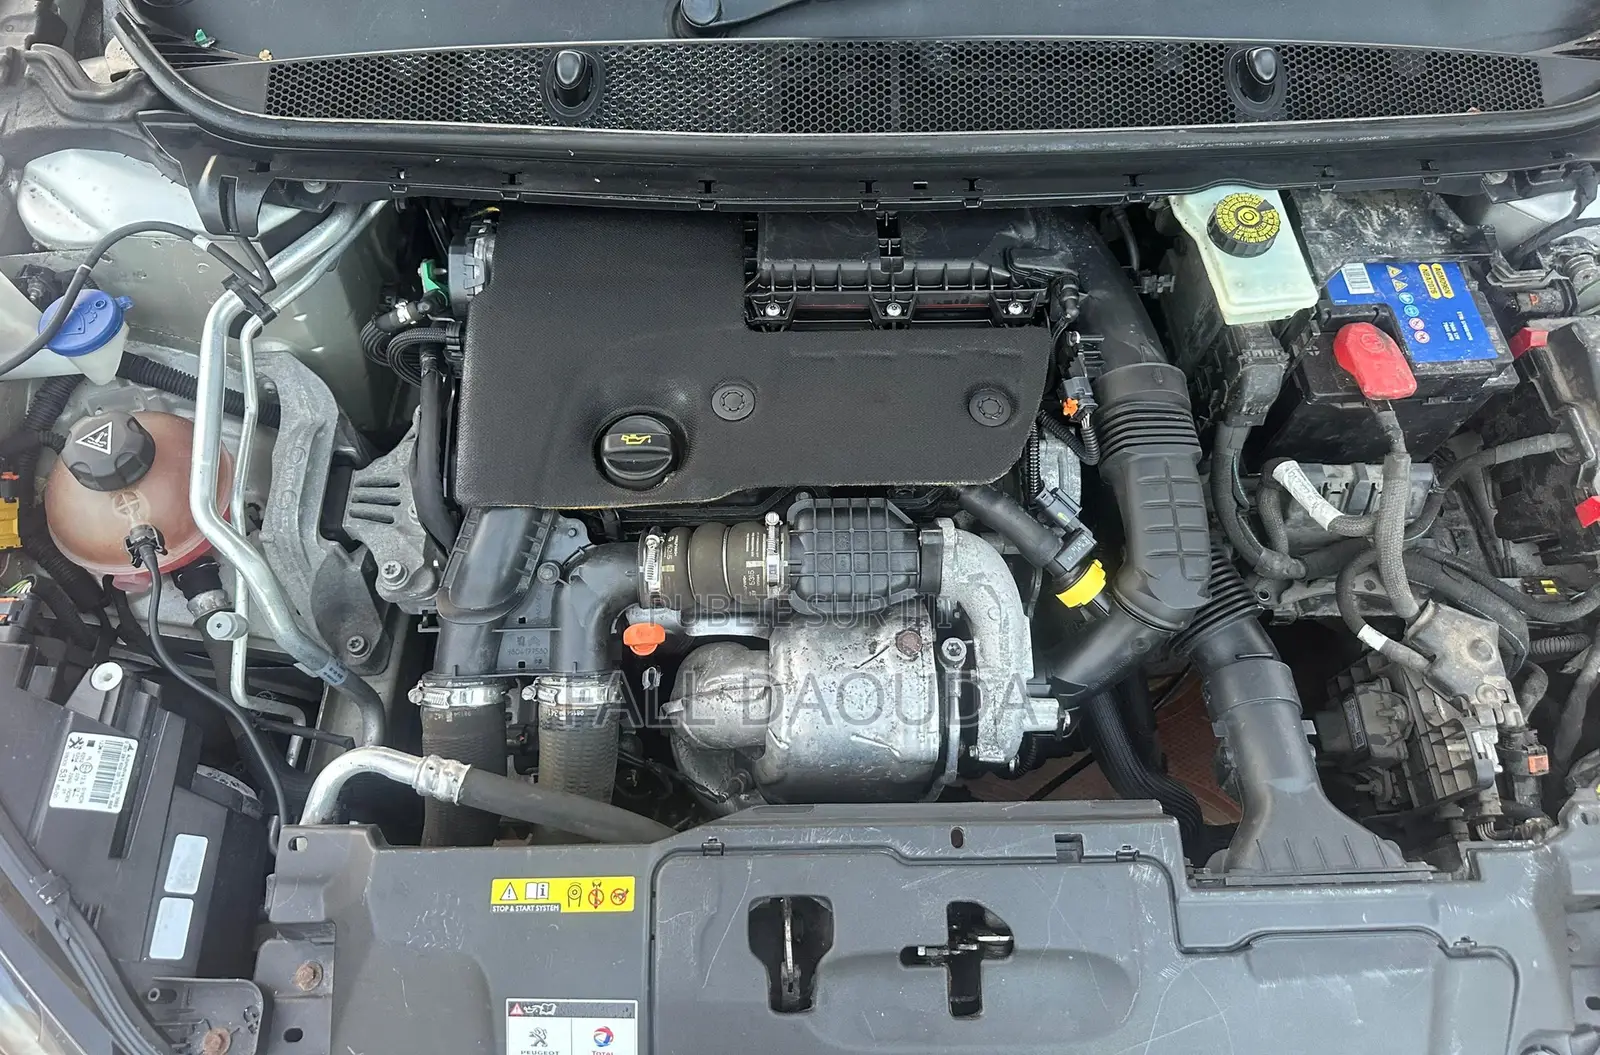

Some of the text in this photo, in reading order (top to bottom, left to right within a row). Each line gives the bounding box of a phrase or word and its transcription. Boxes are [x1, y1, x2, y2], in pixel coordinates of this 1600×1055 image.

[58, 768, 67, 782] 531
[492, 905, 510, 913] STOP
[535, 904, 560, 912] SYSTEM
